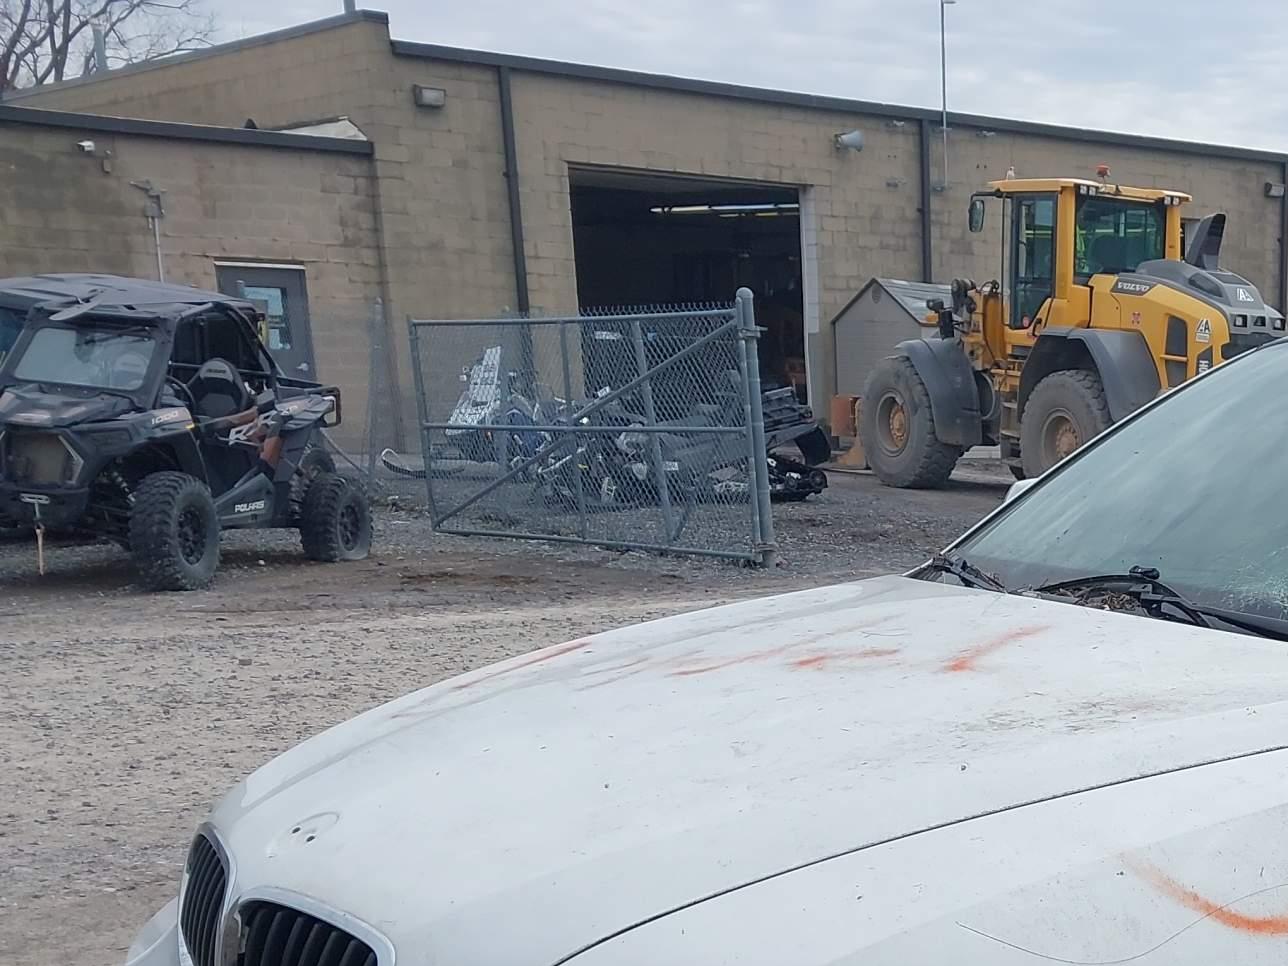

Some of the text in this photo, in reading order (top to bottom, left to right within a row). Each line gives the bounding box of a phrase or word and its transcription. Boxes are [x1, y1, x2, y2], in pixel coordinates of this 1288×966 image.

[1117, 281, 1150, 292] VOLVO
[151, 411, 178, 425] 1000
[234, 500, 265, 513] POLARIS
